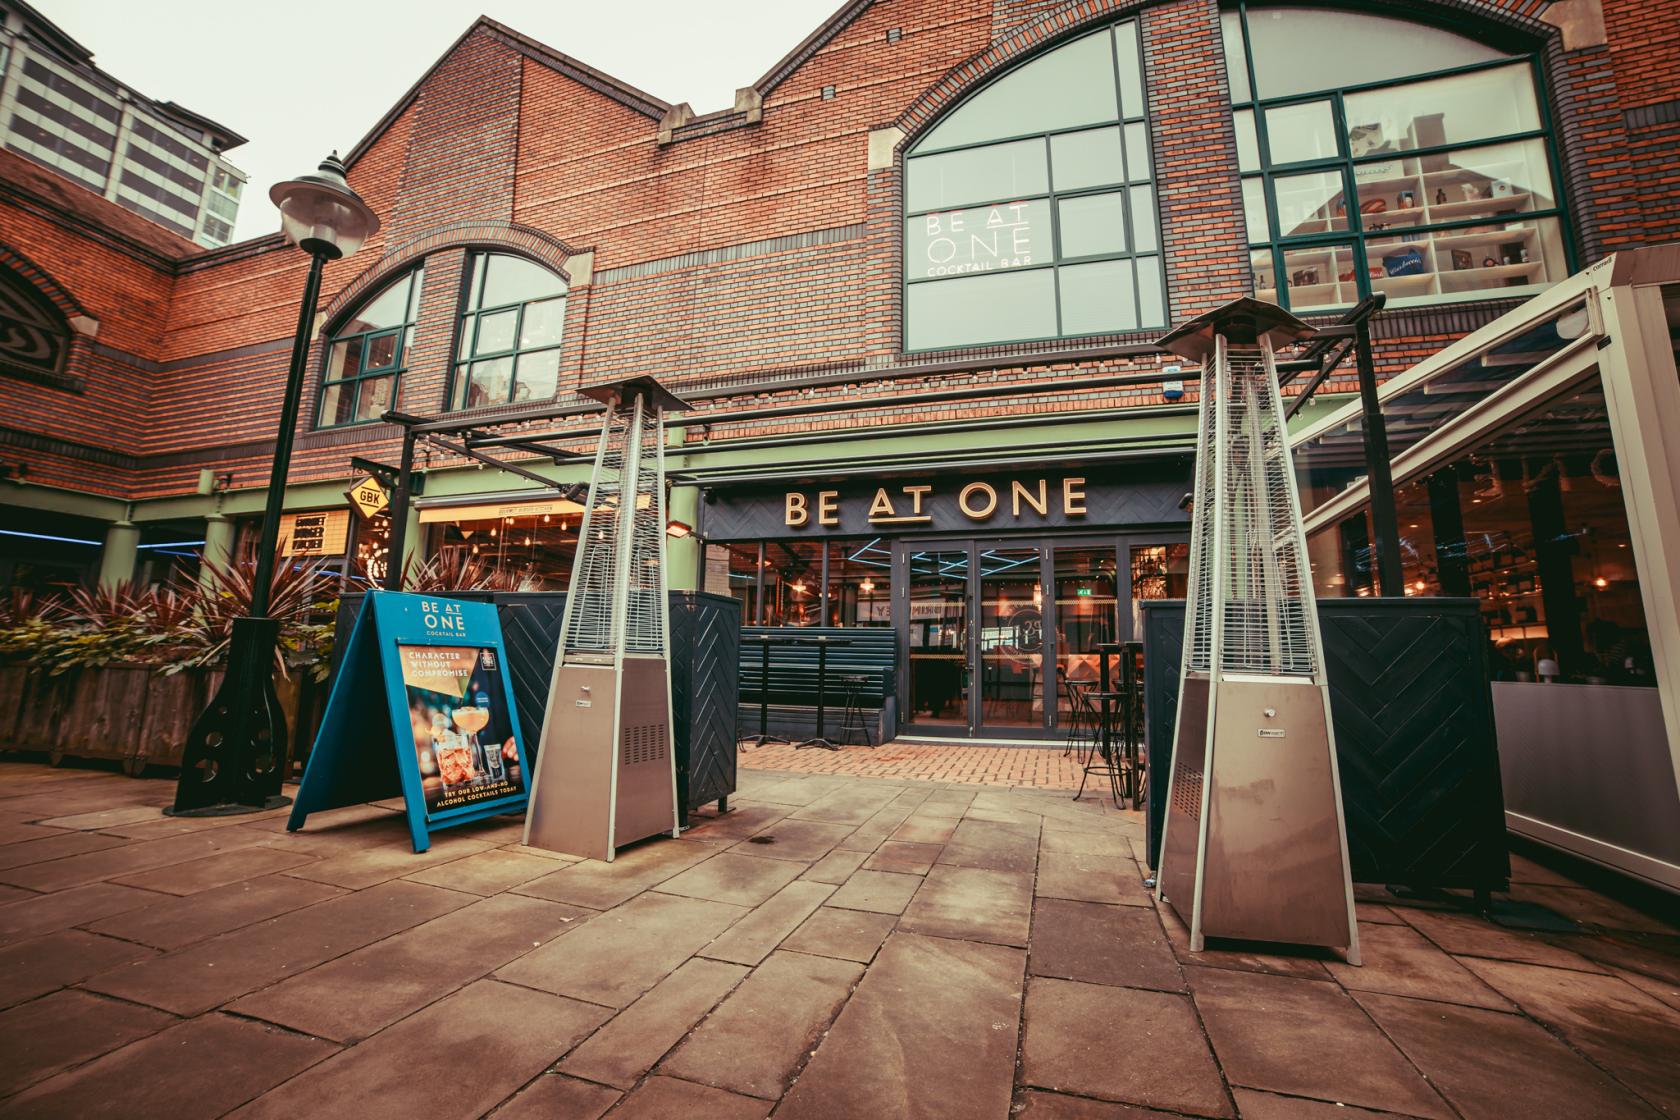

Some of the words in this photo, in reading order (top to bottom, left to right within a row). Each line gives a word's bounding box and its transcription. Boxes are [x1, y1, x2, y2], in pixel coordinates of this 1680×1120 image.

[926, 212, 964, 236] BE
[986, 204, 1029, 226] AT
[927, 227, 1031, 264] ONE
[927, 262, 993, 278] COCKTAIL
[1000, 256, 1032, 268] BAR
[360, 490, 380, 504] GBK
[785, 490, 840, 526] BE
[868, 485, 932, 520] AT
[958, 477, 1087, 520] ONE
[421, 601, 439, 613] BE
[445, 604, 461, 614] AT
[424, 614, 465, 631] ONE
[409, 651, 460, 660] CHARACTER
[411, 669, 468, 677] COMPROMISE
[436, 797, 466, 808] ALCOHOL
[467, 789, 498, 800] COCKTAILS
[444, 790, 456, 798] TRY
